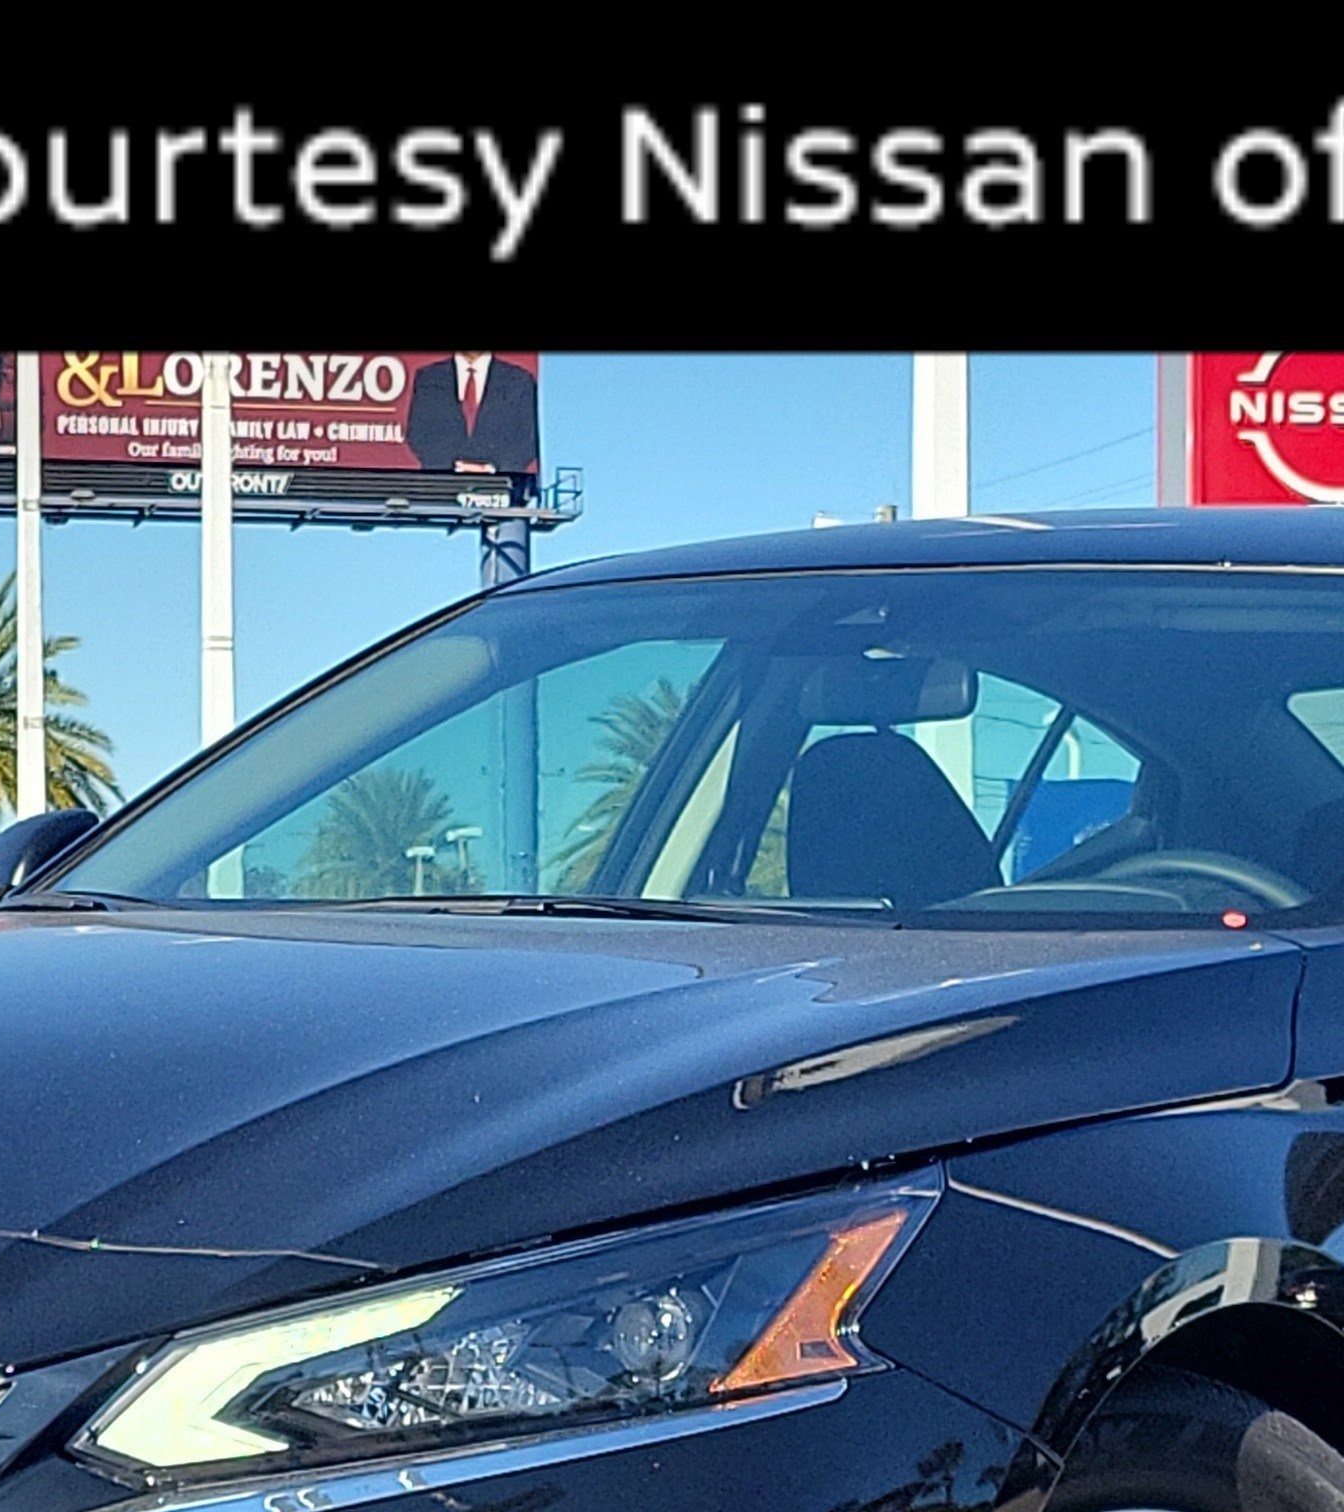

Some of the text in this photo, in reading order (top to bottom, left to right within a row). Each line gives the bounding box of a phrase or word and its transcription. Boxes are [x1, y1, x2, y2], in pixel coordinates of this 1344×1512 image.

[57, 414, 404, 443] PERSONAL INJURY AMILY LAW CRIMINAL
[128, 441, 338, 465] Our famil hting for you!
